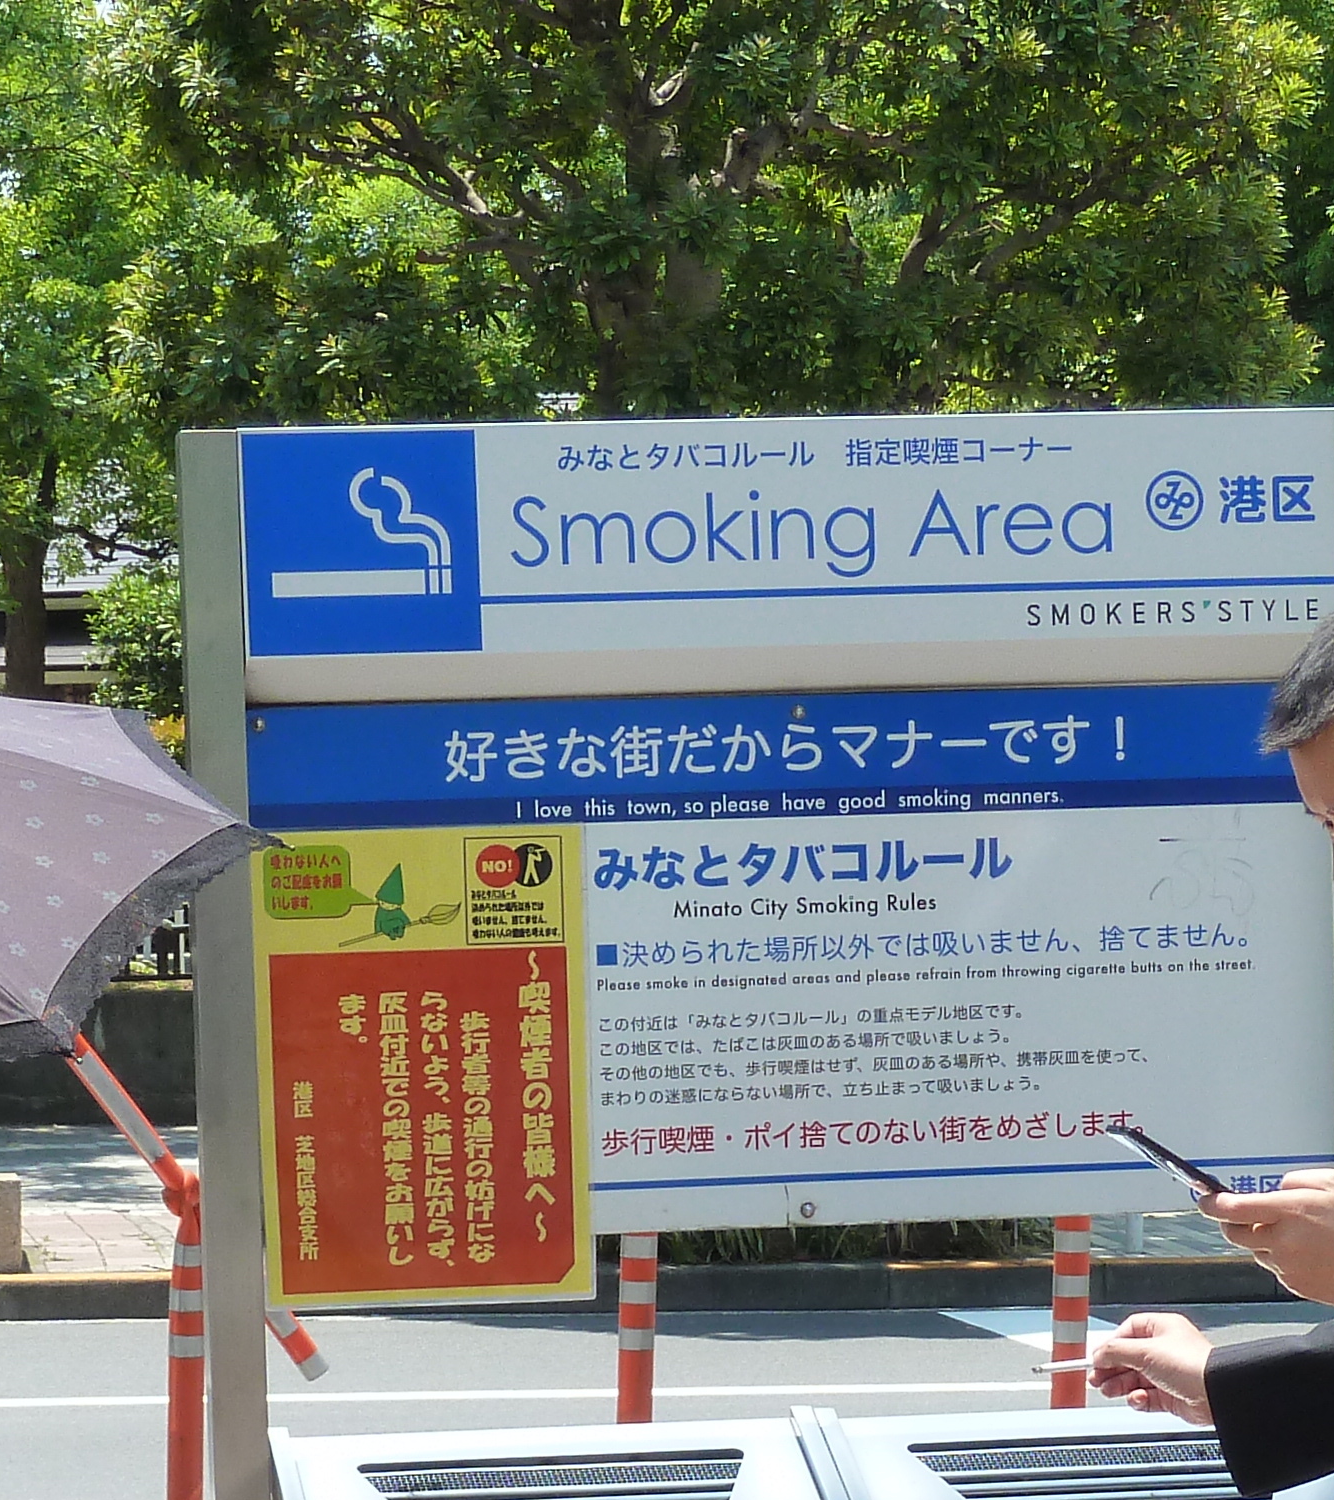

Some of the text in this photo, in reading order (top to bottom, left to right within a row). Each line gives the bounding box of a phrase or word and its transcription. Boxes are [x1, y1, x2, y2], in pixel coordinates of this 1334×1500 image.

[557, 435, 1073, 472] みなとタバコルール 指定喫煙コーナー
[1218, 474, 1316, 526] 港区
[510, 488, 1113, 578] Smoking Area
[444, 714, 1126, 783] 好きな街だからマナーです！
[516, 788, 1065, 819] I love this town, so please have good smoking manners.
[481, 860, 514, 873] NO!
[593, 837, 1014, 891] みなとタバコルール
[673, 893, 937, 920] Minato City Smoking Rules
[597, 978, 641, 992] Please
[646, 976, 688, 990] smoke
[694, 975, 706, 988] in
[711, 972, 787, 989] designated
[792, 974, 830, 985] areas
[835, 970, 861, 983] and
[866, 969, 910, 984] please
[916, 964, 961, 980] refrain
[966, 964, 997, 979] from
[1002, 963, 1061, 980] throwing
[1066, 961, 1125, 977] cigarette
[1131, 959, 1163, 973] butts
[1168, 962, 1184, 972] on
[1189, 958, 1209, 971] the
[338, 994, 368, 1044] ます。
[293, 1081, 313, 1118] 港区
